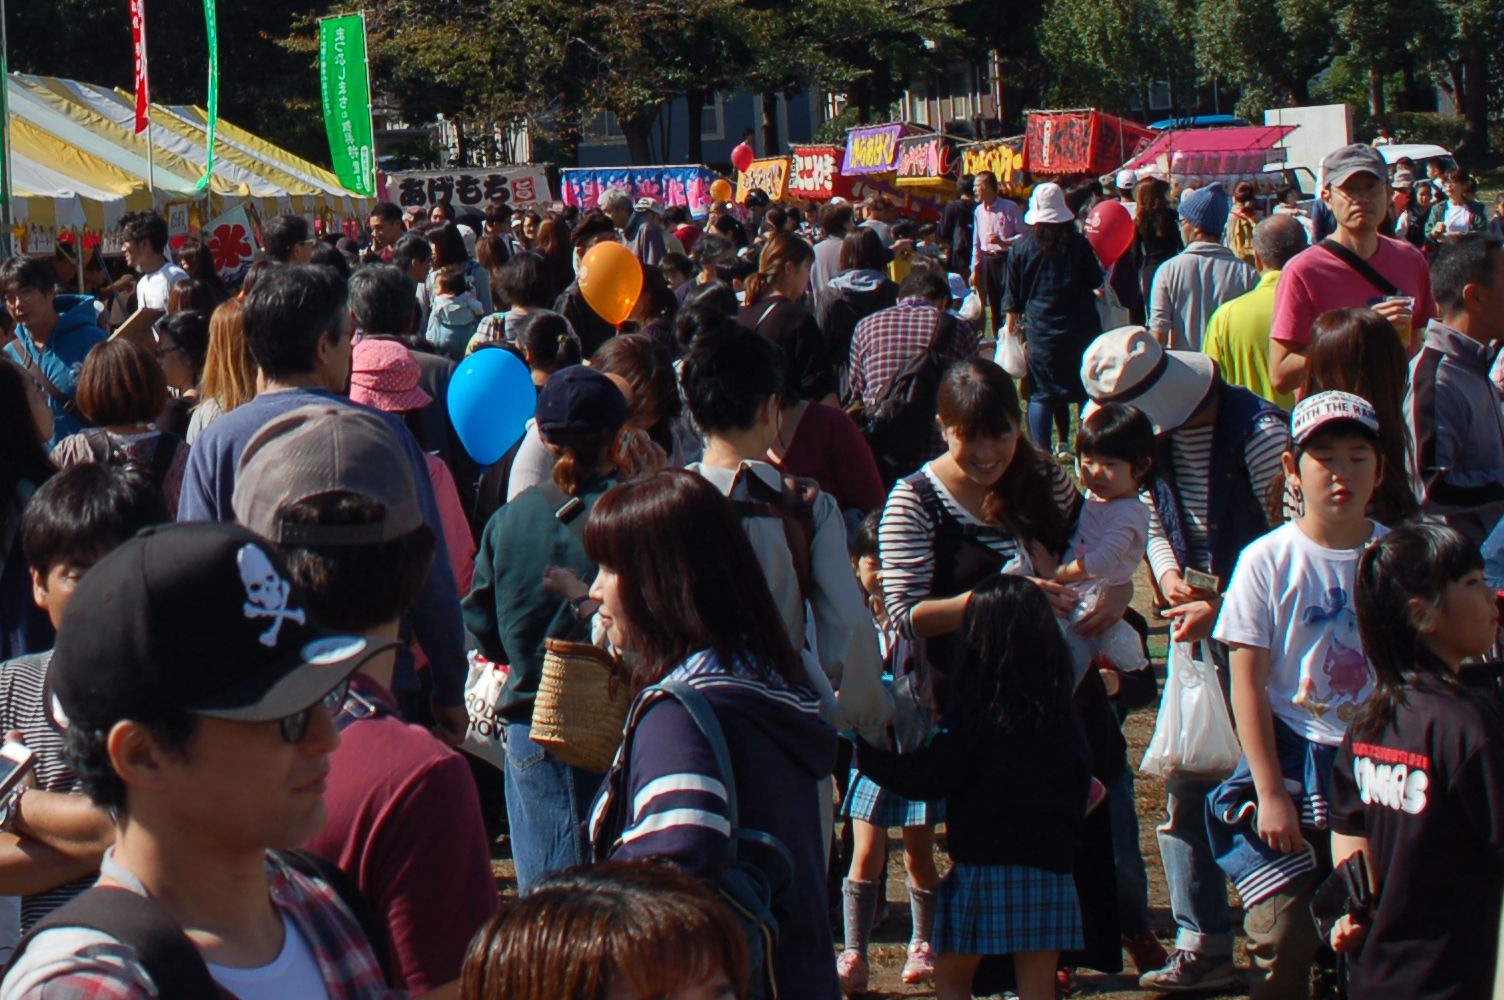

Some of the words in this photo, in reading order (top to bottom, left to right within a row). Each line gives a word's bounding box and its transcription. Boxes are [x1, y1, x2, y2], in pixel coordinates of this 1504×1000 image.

[399, 174, 510, 206] あげもち
[1325, 402, 1349, 413] THE
